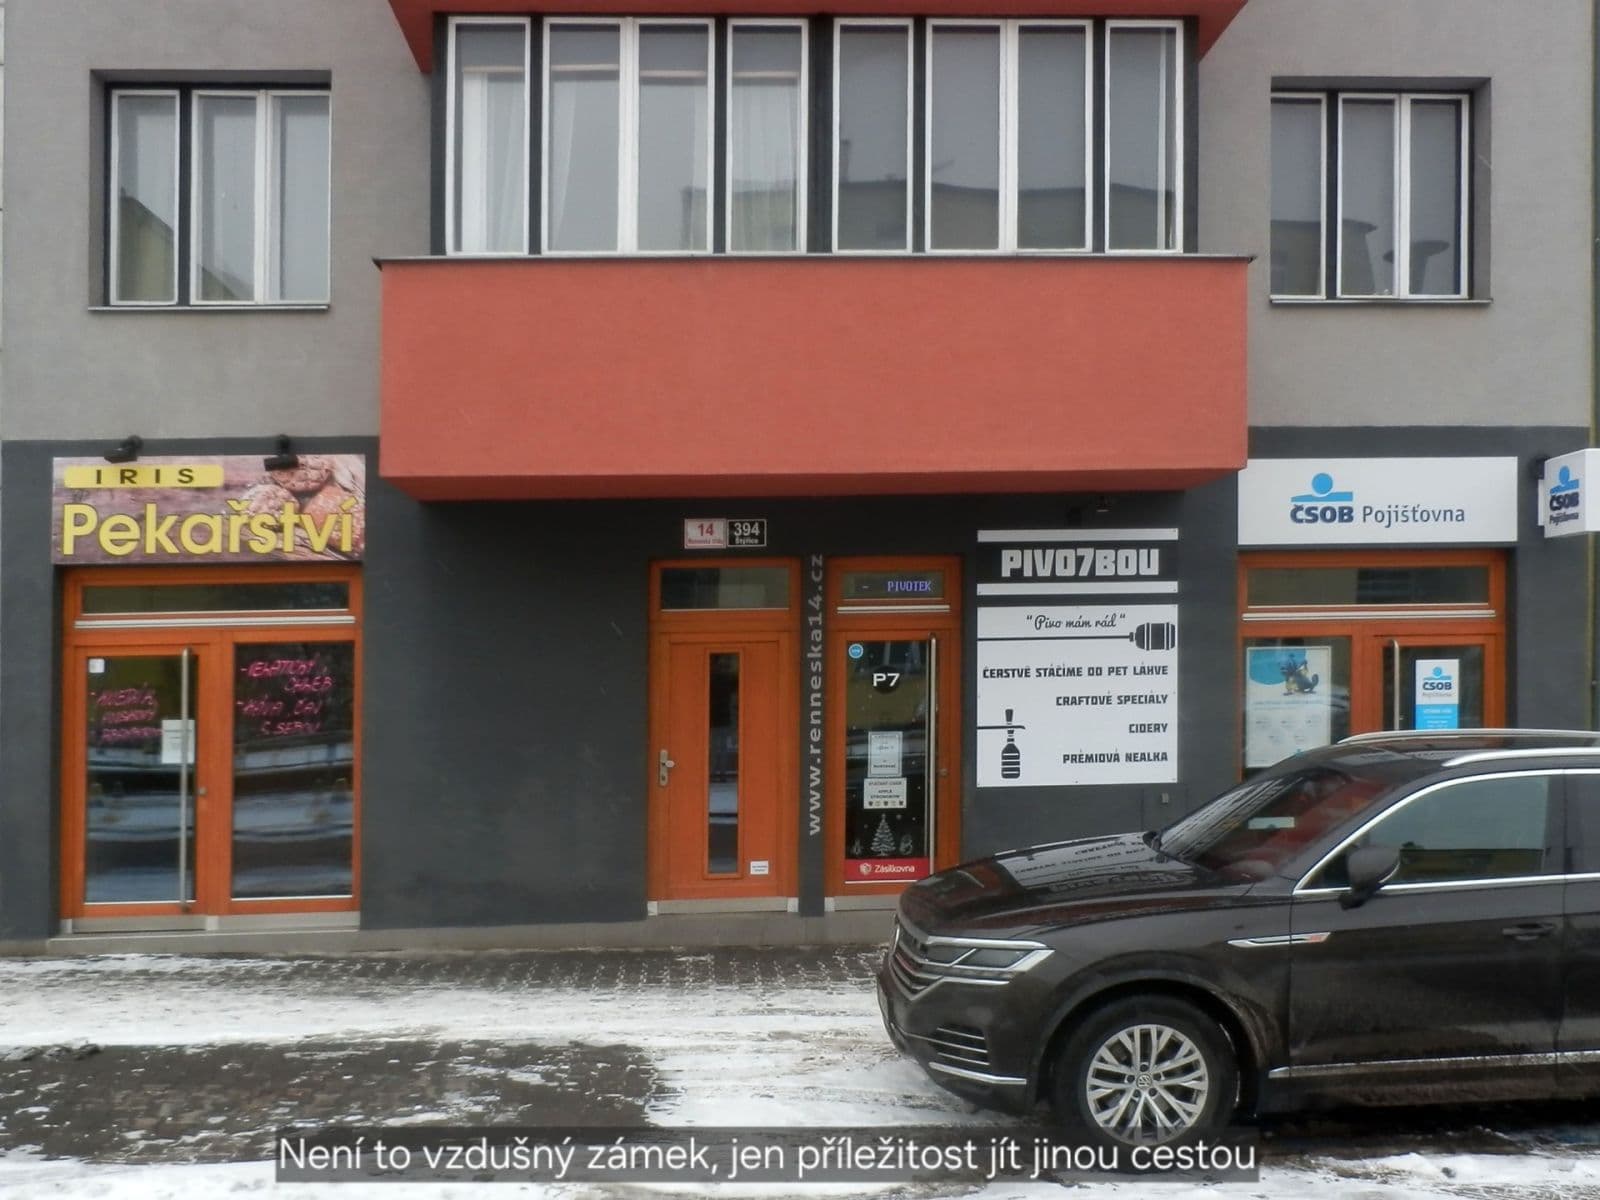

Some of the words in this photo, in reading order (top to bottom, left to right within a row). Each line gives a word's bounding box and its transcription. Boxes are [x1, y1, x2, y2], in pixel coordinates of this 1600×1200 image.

[95, 467, 195, 485] IRIS
[1290, 503, 1354, 525] ČSOB
[1362, 503, 1466, 529] Pojišťovna
[62, 497, 359, 557] Pekařství
[696, 522, 715, 537] 14
[733, 521, 760, 538] 394
[1001, 547, 1160, 578] PIVO7BOU
[886, 580, 933, 592] PIVOTEK
[1065, 615, 1092, 629] mám
[1087, 666, 1103, 677] OD
[1107, 665, 1128, 676] PET
[1132, 661, 1169, 676] LÁHVE
[872, 672, 901, 687] P7
[807, 554, 824, 836] www.renneska14.cz
[1055, 690, 1113, 706] CRAFTOVÉ
[1116, 689, 1169, 705] SPECIÁLY
[1128, 722, 1169, 734] CIDERY
[1062, 748, 1121, 764] PRÉMIOVÁ
[1125, 751, 1169, 763] NEALKA
[874, 863, 916, 874] Zásilkovna
